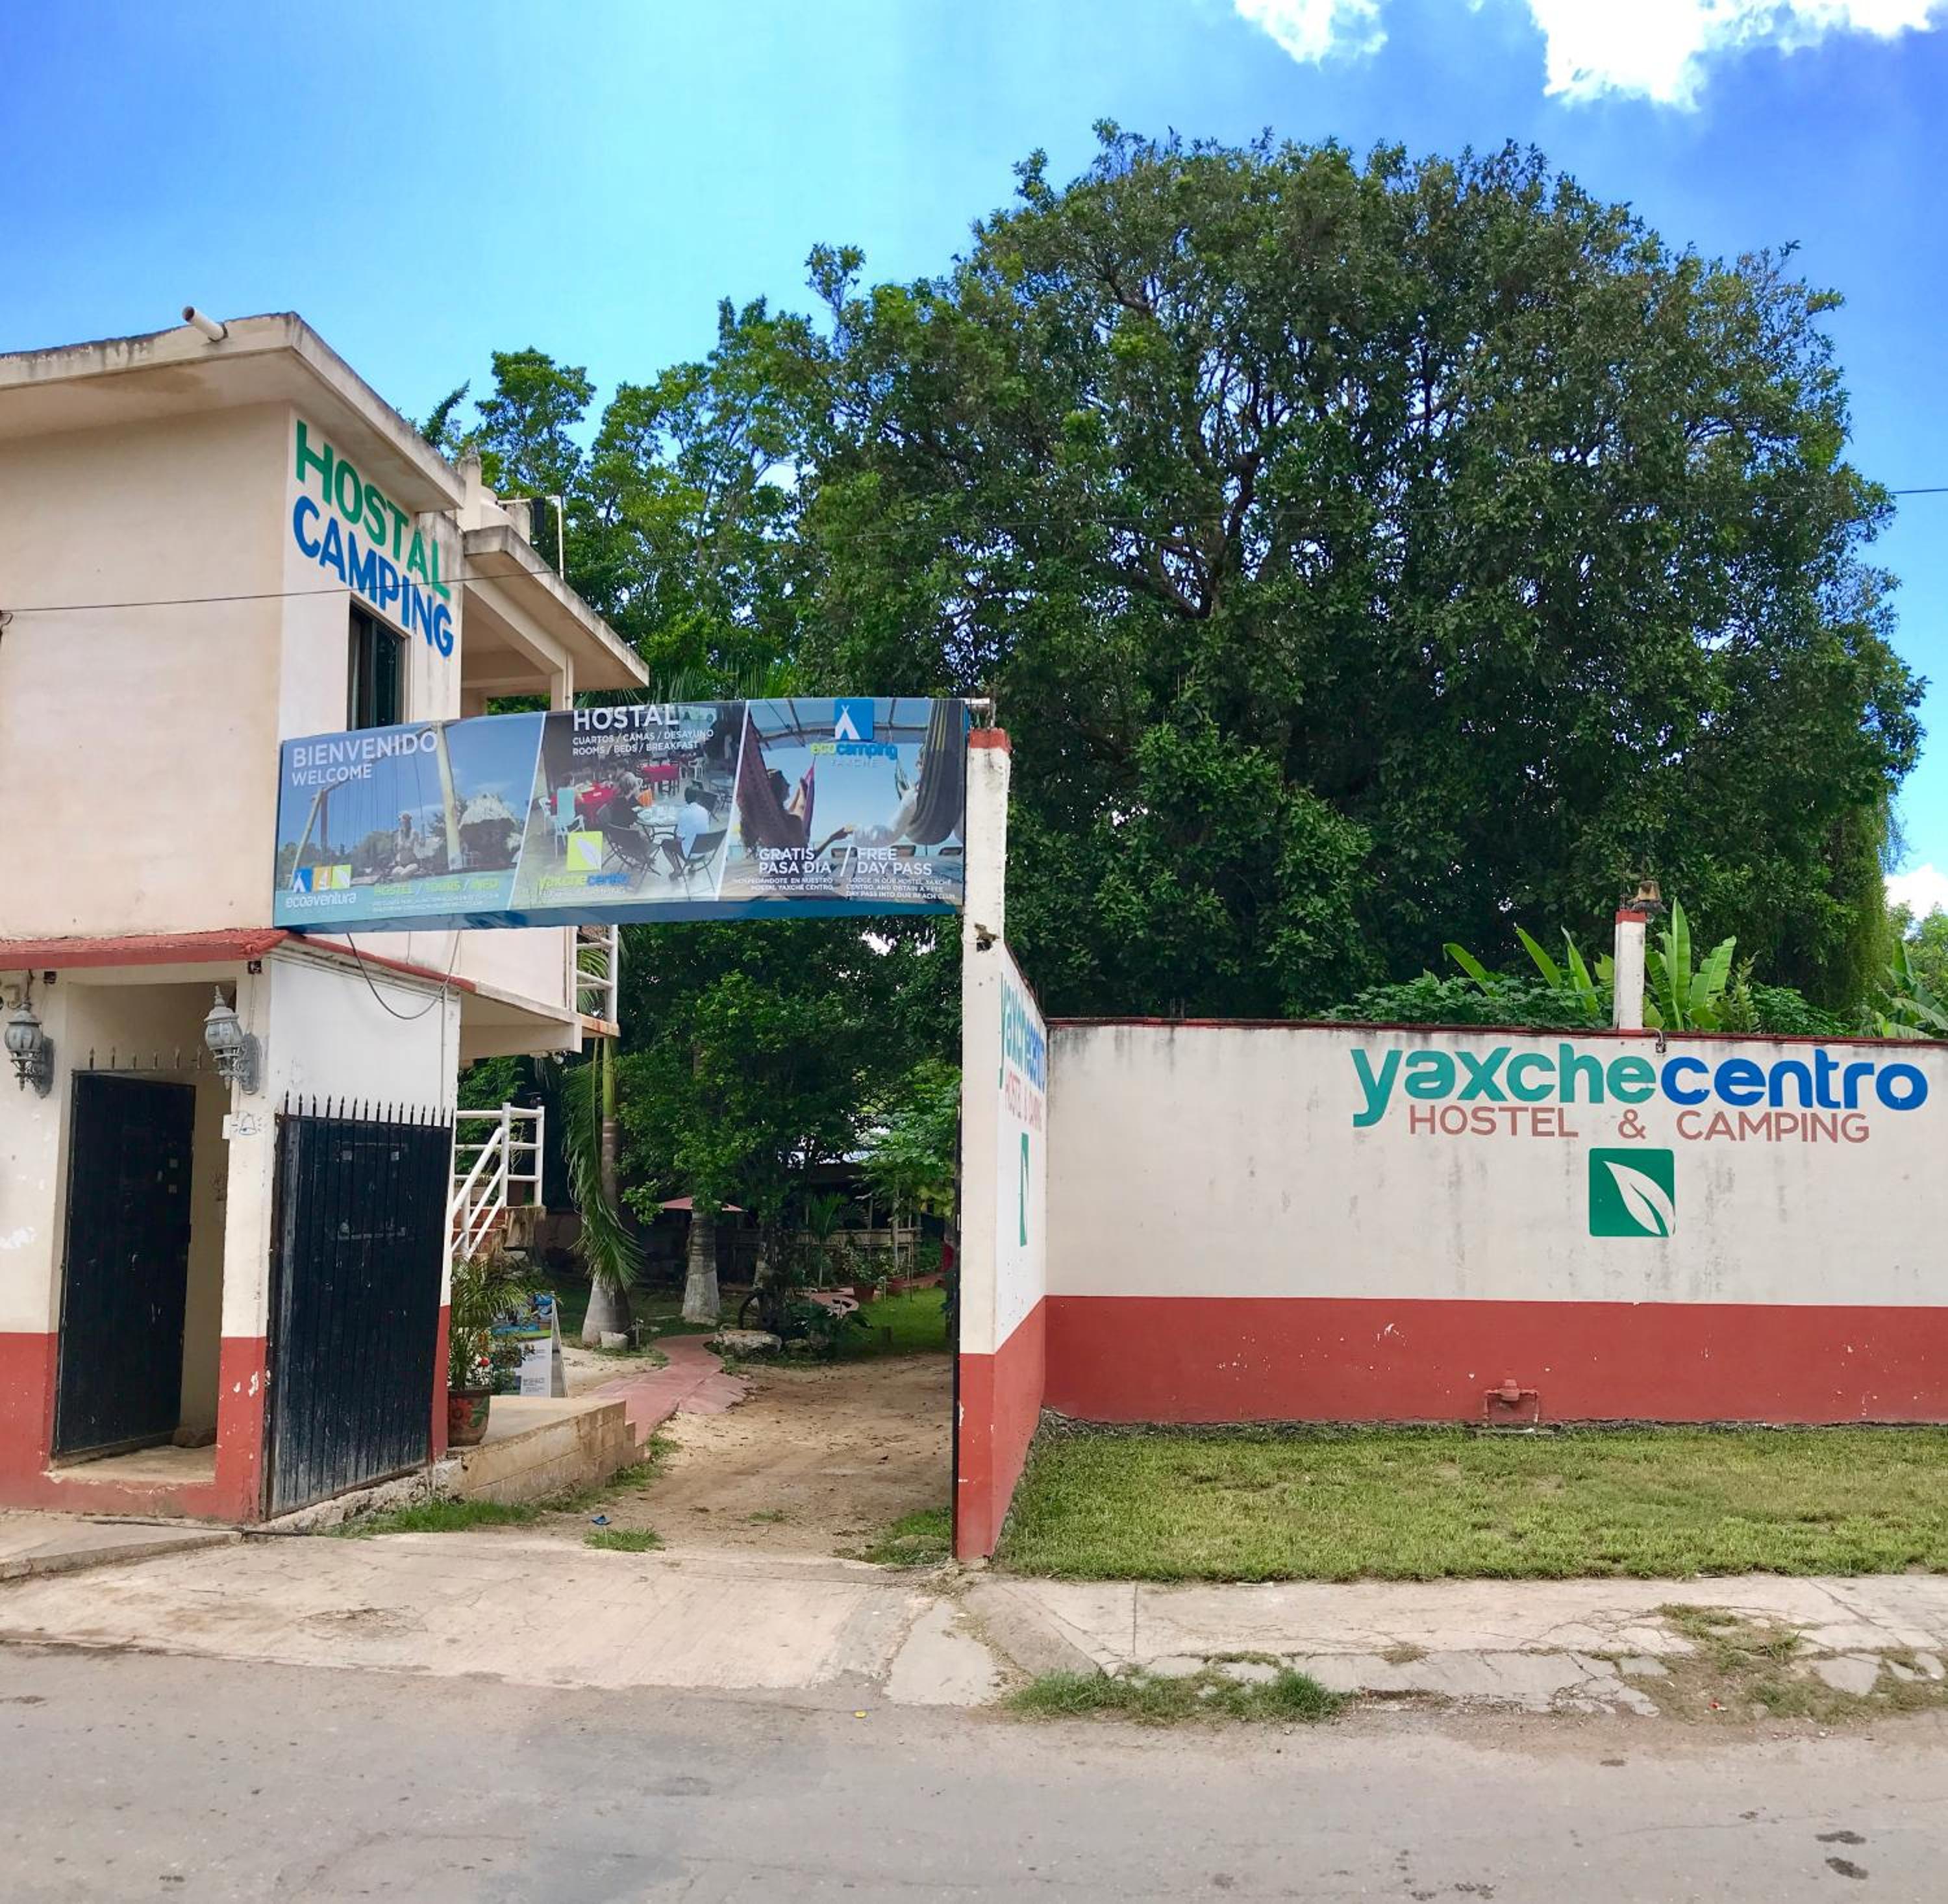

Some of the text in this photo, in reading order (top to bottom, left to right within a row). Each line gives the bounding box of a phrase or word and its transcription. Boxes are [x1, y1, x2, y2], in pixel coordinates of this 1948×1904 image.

[296, 419, 451, 601] HOSTAL
[293, 495, 454, 657] CAMPING
[573, 704, 679, 732] HOSTAL
[572, 734, 614, 745] CUARTOS
[623, 732, 655, 742] CAMAS
[664, 729, 714, 740] DESAYUNO
[572, 745, 605, 756] ROOMS
[614, 743, 636, 753] BEDS
[646, 741, 697, 751] BREAKFAST
[292, 731, 438, 768] BIENVENIDO
[292, 763, 372, 786] WELCOME
[758, 847, 815, 861] GRATIS
[857, 847, 897, 861] FREE
[758, 861, 799, 874] PASA
[857, 862, 932, 875] DAY PASS
[1350, 1043, 1929, 1128] yaxchecentro
[1409, 1104, 1870, 1144] HOSTEL & CAMPING
